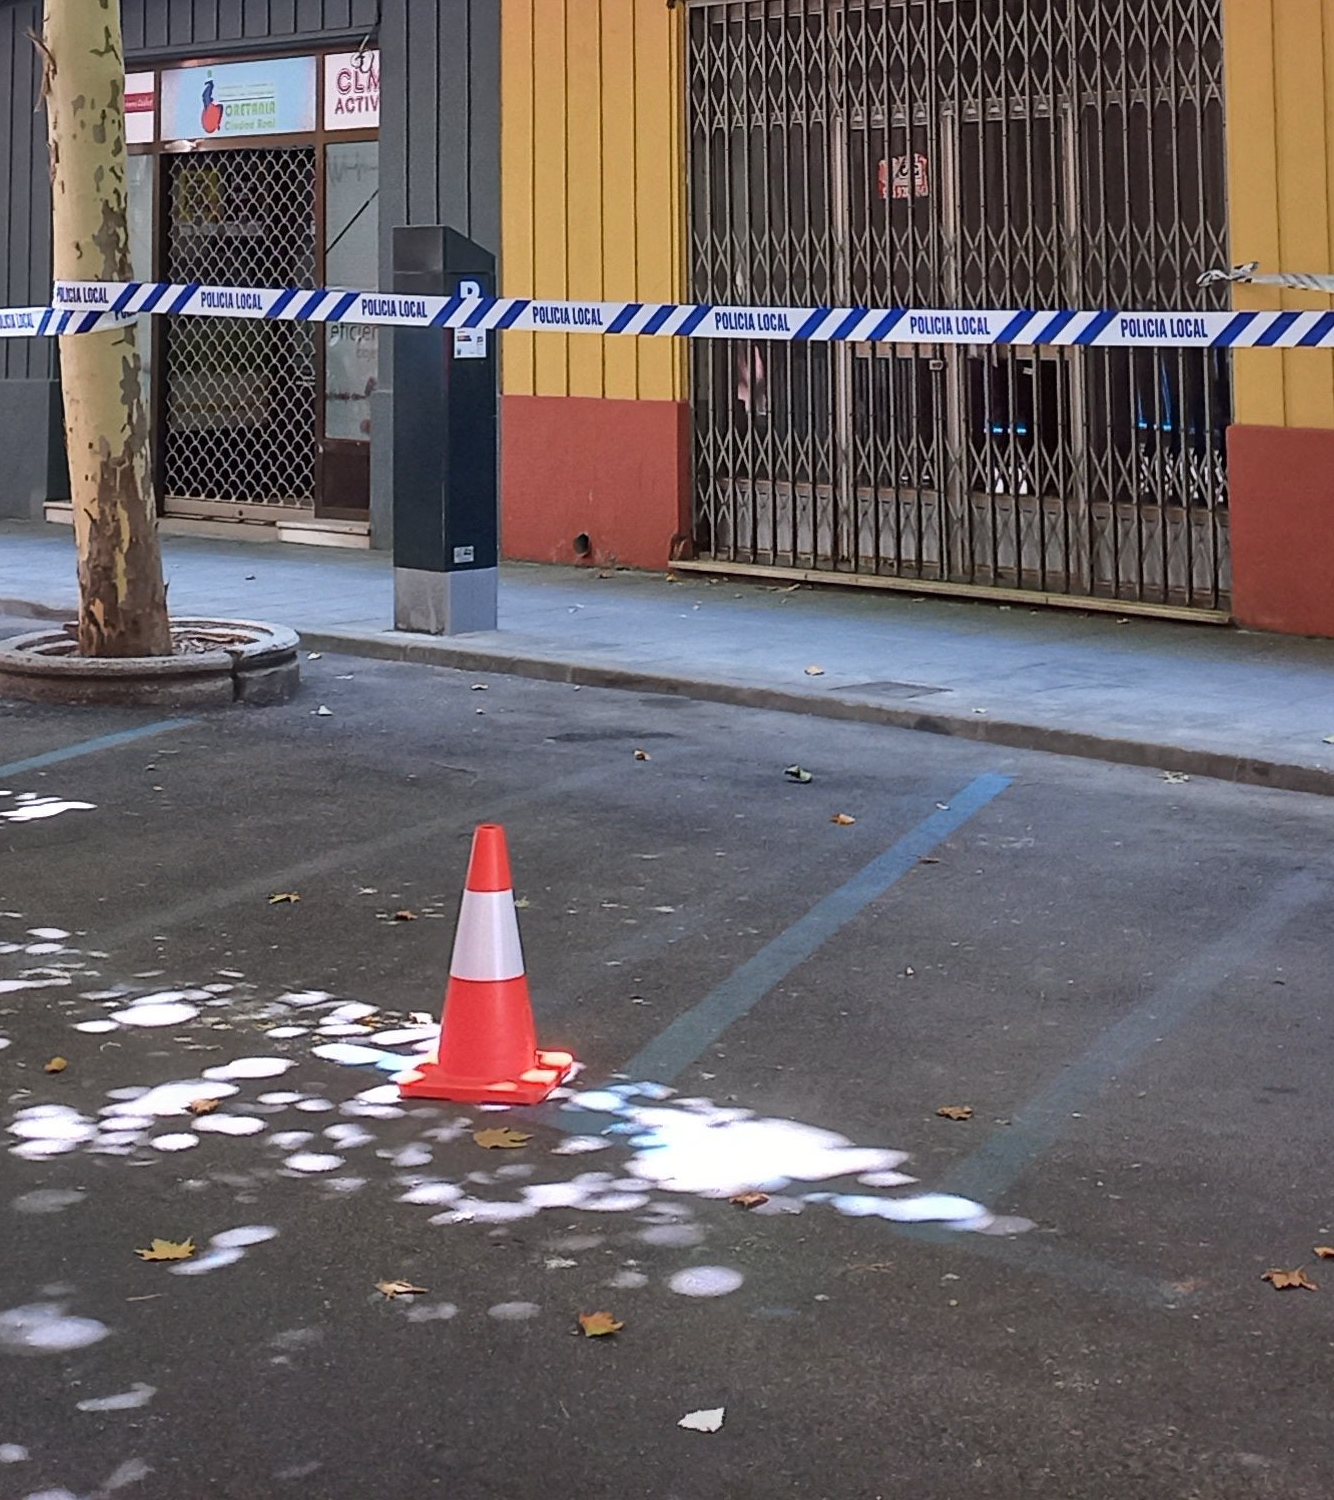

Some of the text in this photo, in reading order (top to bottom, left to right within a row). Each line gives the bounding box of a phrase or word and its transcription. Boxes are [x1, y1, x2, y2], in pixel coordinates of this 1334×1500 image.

[83, 287, 109, 304] LOCAL
[200, 290, 263, 311] POLICIA LOCAL
[361, 298, 428, 319] POLICIA LOCAL
[532, 306, 603, 326] POLICIA LOCAL
[714, 311, 791, 332] POLICIA LOCAL
[910, 315, 991, 336] POLICIA LOCAL
[1120, 317, 1209, 339] POLICIA LOCAL
